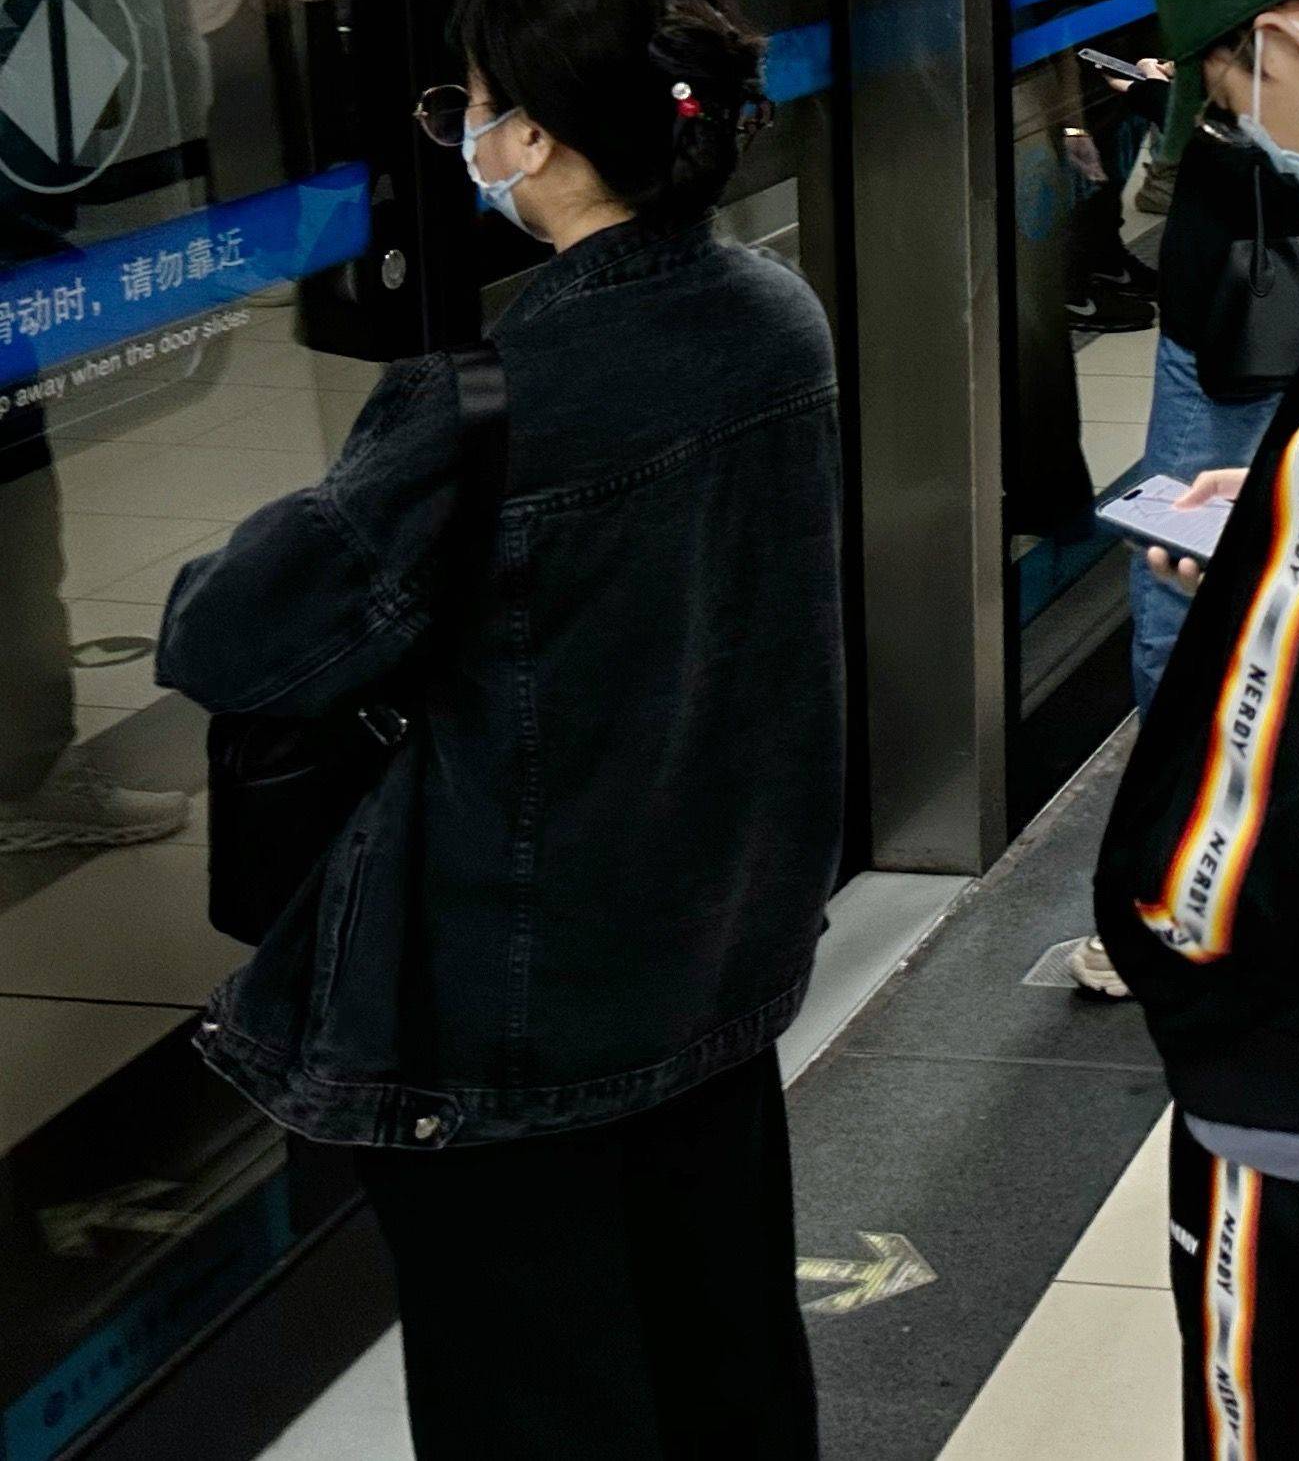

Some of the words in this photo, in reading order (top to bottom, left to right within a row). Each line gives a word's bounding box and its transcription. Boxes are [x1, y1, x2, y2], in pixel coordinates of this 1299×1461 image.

[14, 372, 68, 408] away
[71, 354, 122, 386] when
[125, 341, 156, 367] the
[159, 325, 199, 354] door
[202, 308, 250, 339] slides
[1229, 663, 1268, 760] NERDY
[1185, 830, 1227, 919] NERDY
[1216, 1209, 1236, 1297] NERDY
[1215, 1365, 1240, 1440] NERDY
